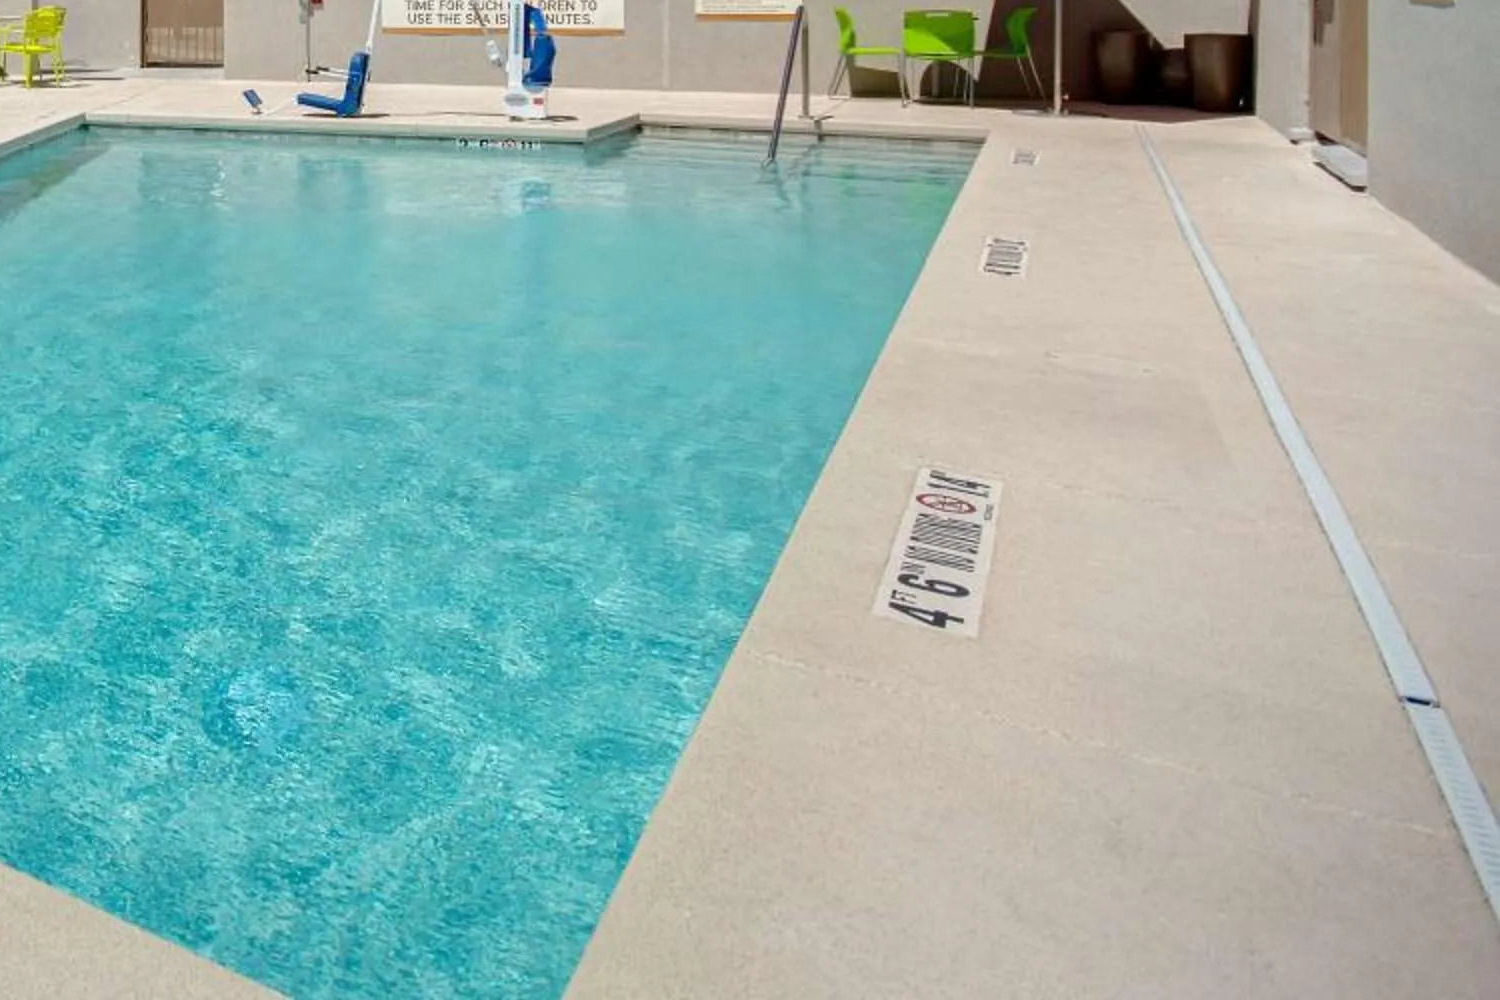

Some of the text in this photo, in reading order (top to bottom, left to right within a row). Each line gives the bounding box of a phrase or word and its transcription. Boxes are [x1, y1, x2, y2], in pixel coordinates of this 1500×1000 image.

[405, 0, 435, 11] TIME
[439, 0, 463, 11] FOR
[468, 0, 503, 11] SUCH
[581, 0, 598, 11] TO
[408, 13, 432, 25] USE
[436, 13, 461, 25] THE
[495, 13, 507, 25] IS
[897, 573, 970, 597] 6
[888, 601, 965, 628] 4
